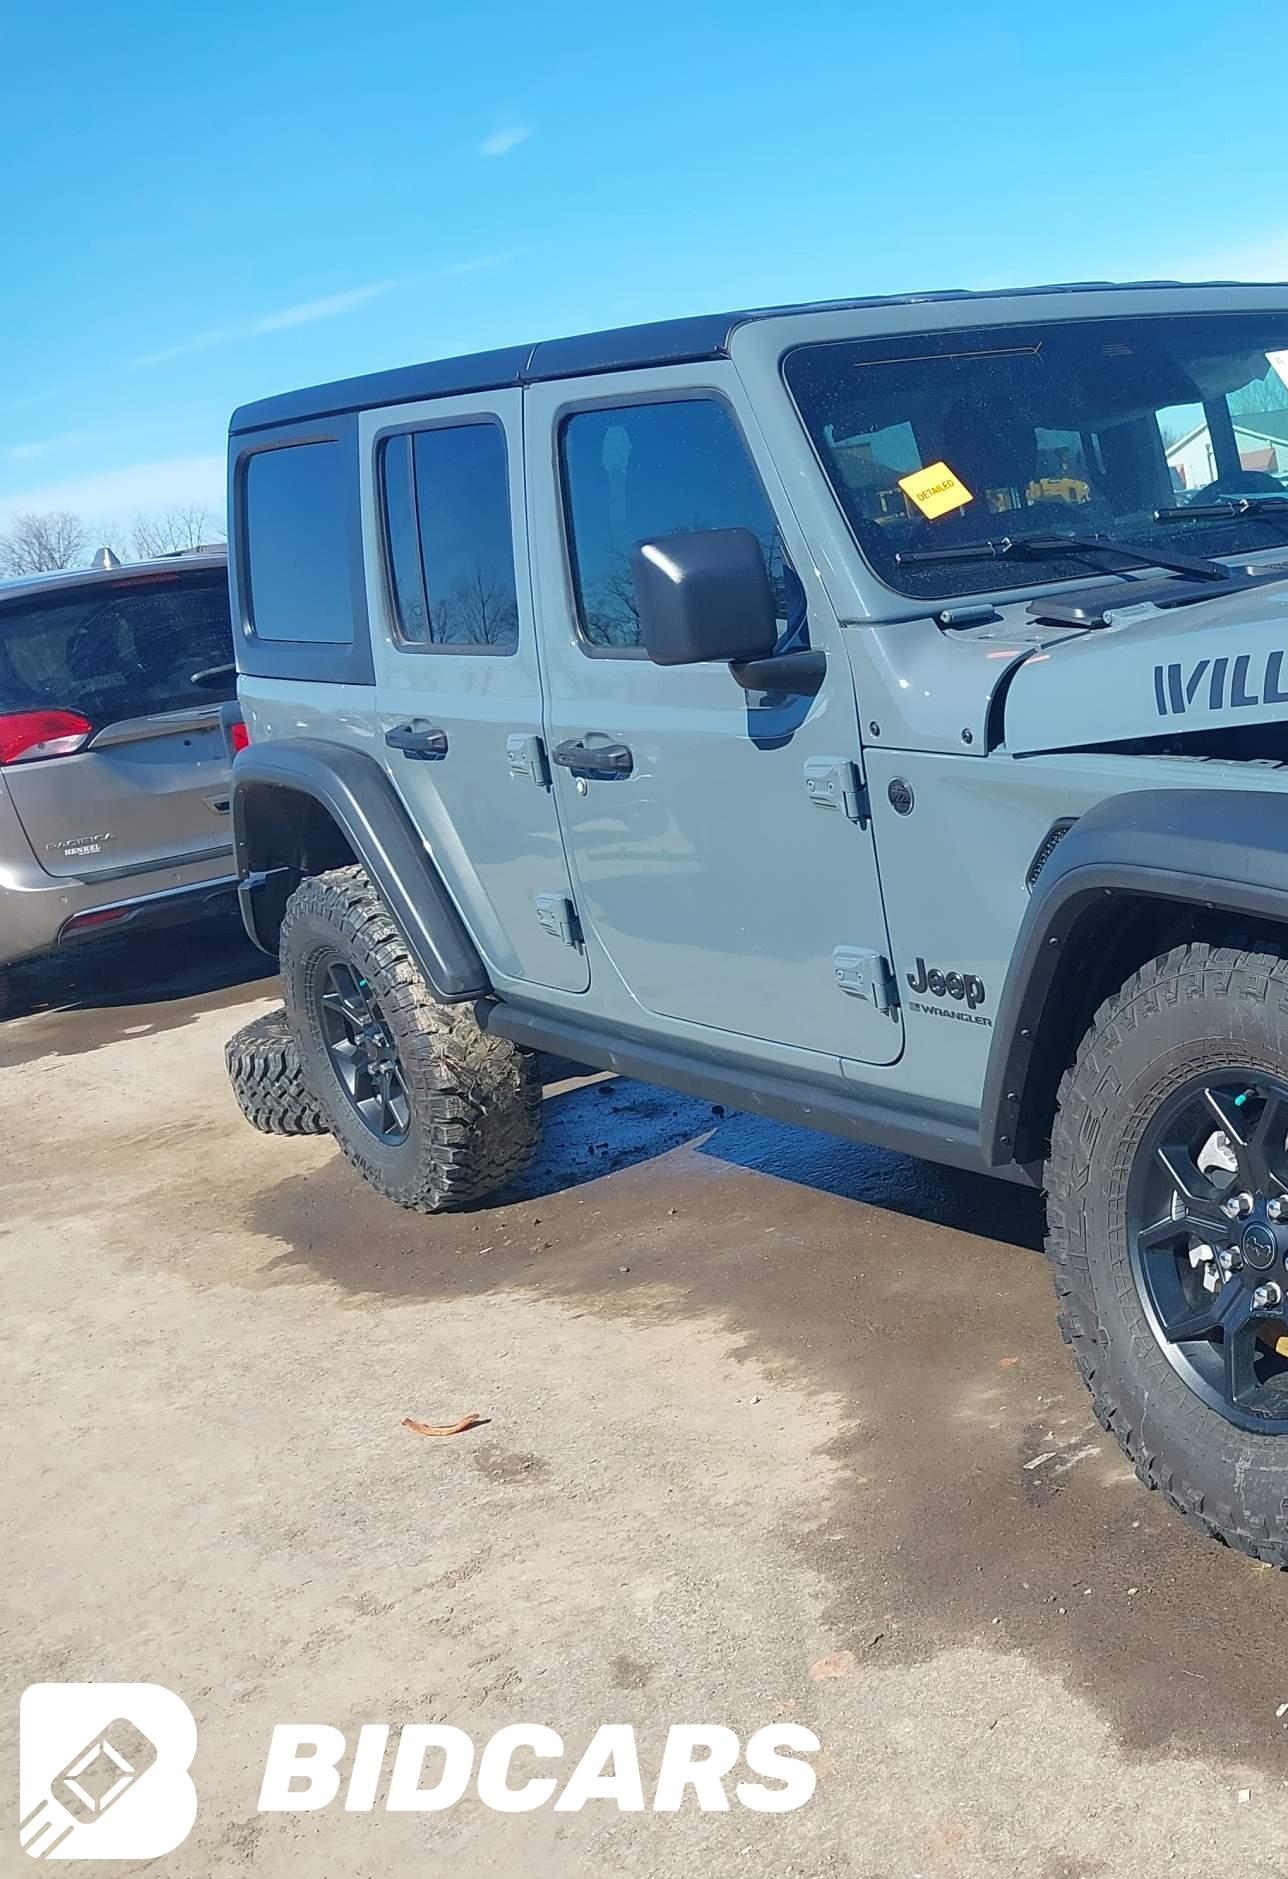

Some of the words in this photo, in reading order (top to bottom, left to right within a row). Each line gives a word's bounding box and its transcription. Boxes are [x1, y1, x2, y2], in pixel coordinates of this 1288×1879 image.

[916, 479, 955, 501] DETAILED
[906, 957, 986, 1010] Jeep
[920, 1003, 993, 1027] WRANGLER
